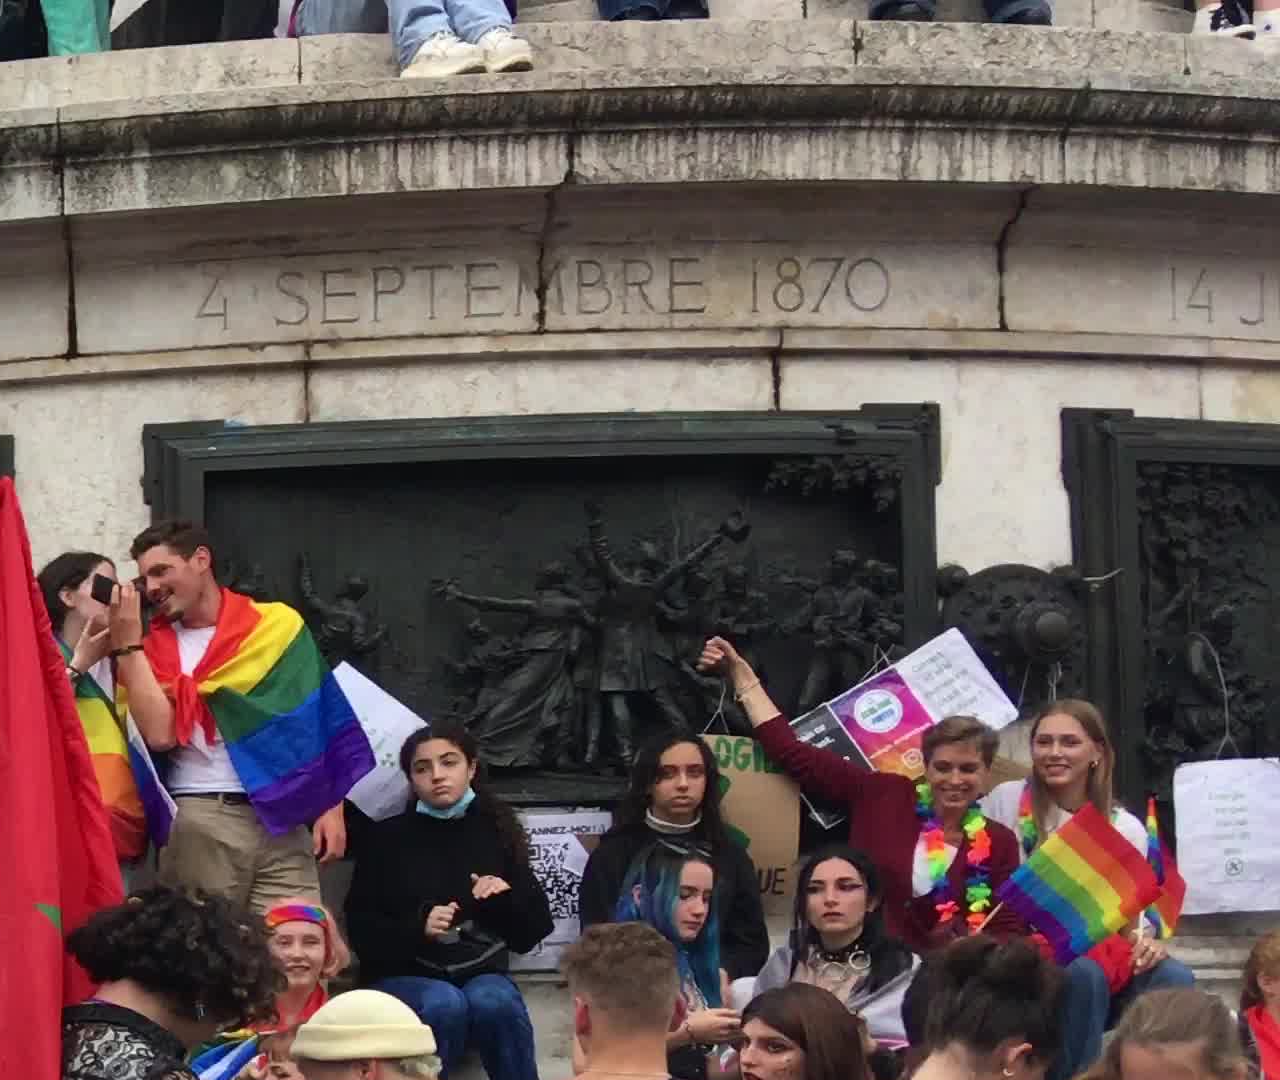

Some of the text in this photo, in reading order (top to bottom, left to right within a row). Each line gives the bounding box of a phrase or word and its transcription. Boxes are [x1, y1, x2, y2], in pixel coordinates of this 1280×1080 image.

[195, 256, 890, 331] 4 SEPTEMBRE 1870
[1168, 264, 1214, 323] 14
